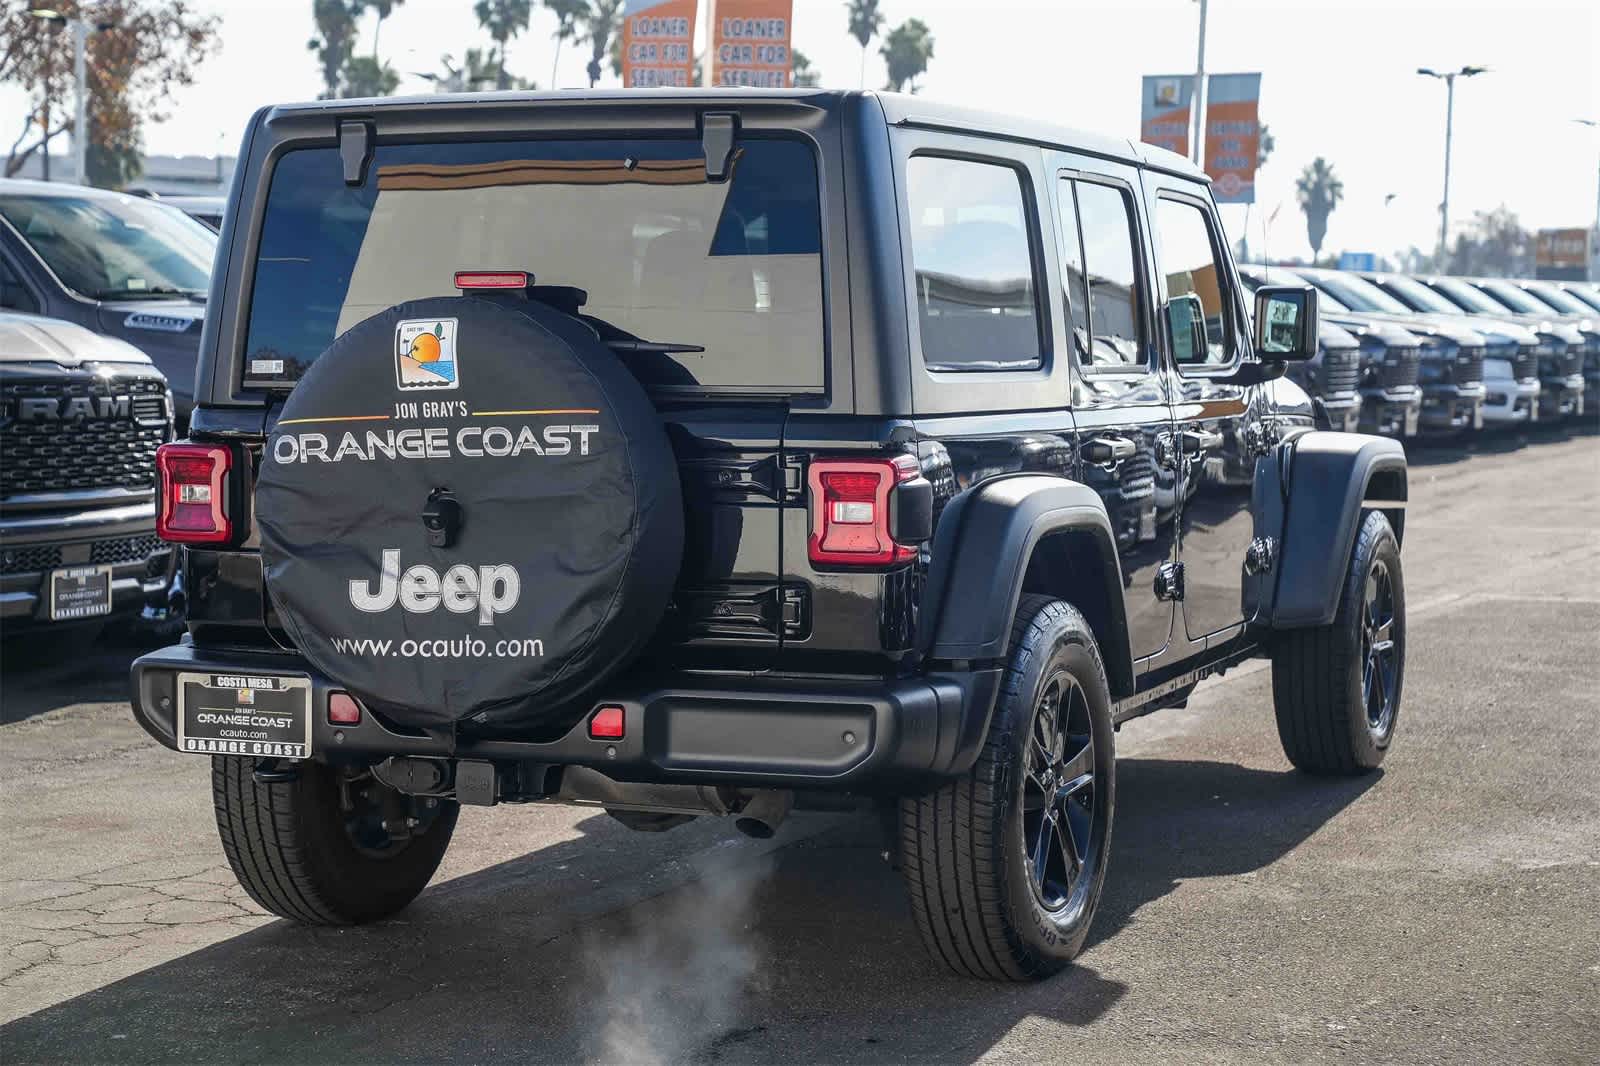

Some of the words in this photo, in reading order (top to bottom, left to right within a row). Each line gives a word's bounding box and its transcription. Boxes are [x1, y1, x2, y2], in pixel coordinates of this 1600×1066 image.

[631, 17, 688, 37] LOANER
[723, 18, 785, 38] LOANER
[629, 42, 657, 63] CAR
[662, 43, 688, 63] FOR
[720, 44, 752, 64] CAR
[757, 45, 787, 64] FOR
[21, 396, 129, 419] RAM
[394, 403, 418, 419] JON
[423, 401, 468, 418] GRAY'S
[274, 427, 451, 464] ORANGE
[456, 424, 599, 457] COAST
[349, 548, 521, 626] Jeep
[330, 634, 544, 657] www.ocauto.com
[217, 676, 246, 688] COSTA
[248, 677, 273, 689] MESA
[197, 713, 250, 726] ORANGE
[250, 716, 293, 728] COAST
[220, 728, 268, 739] ocauto.com
[187, 739, 247, 753] ORANGE
[253, 743, 302, 756] COAST
